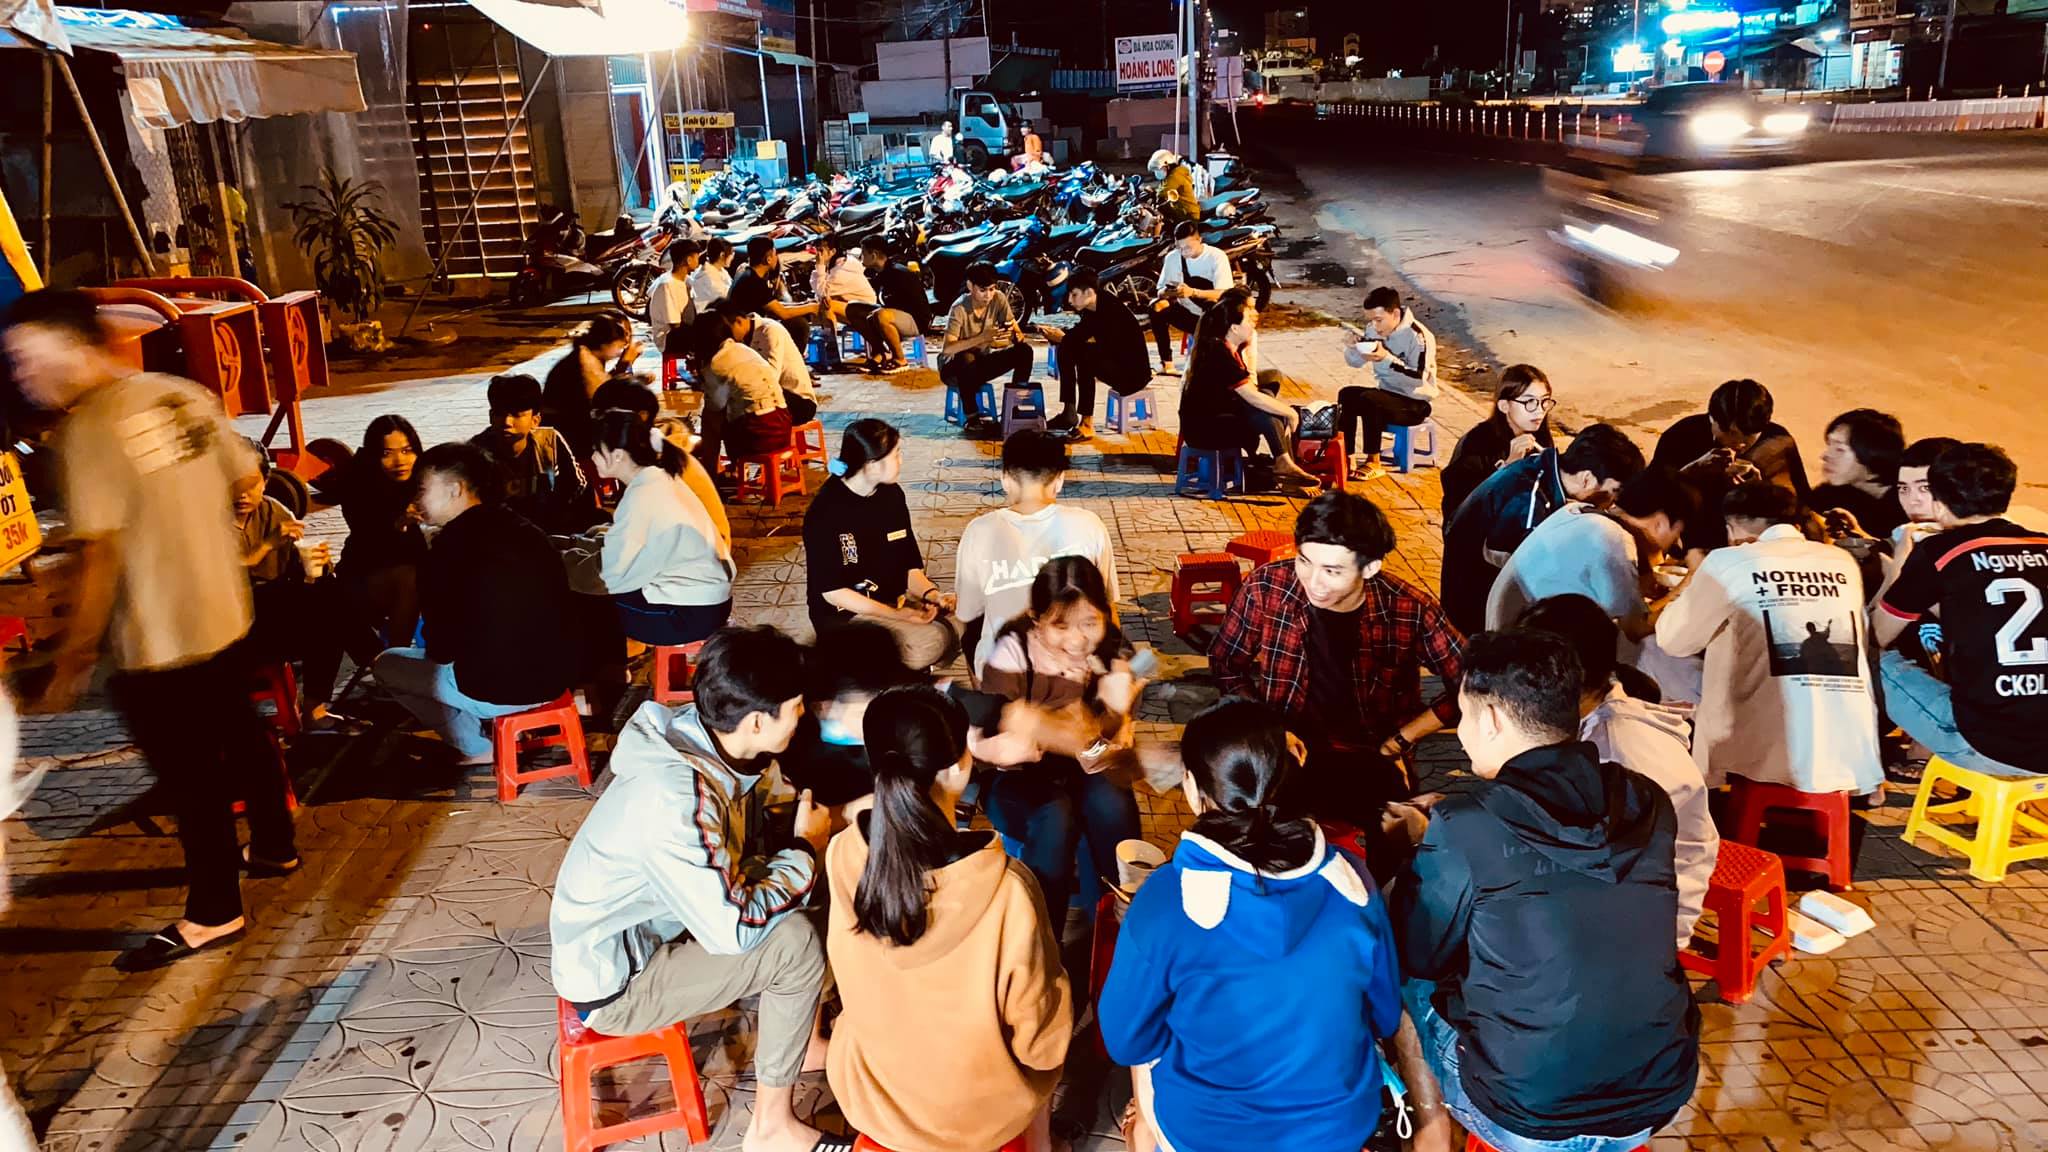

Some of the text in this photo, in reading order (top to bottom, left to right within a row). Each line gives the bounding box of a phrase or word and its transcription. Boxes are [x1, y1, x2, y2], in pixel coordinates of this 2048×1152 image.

[1142, 41, 1154, 52] HOA
[1119, 56, 1175, 80] HOÀNG LONG
[1752, 570, 1847, 585] NOTHING
[1756, 583, 1840, 598] + FROM
